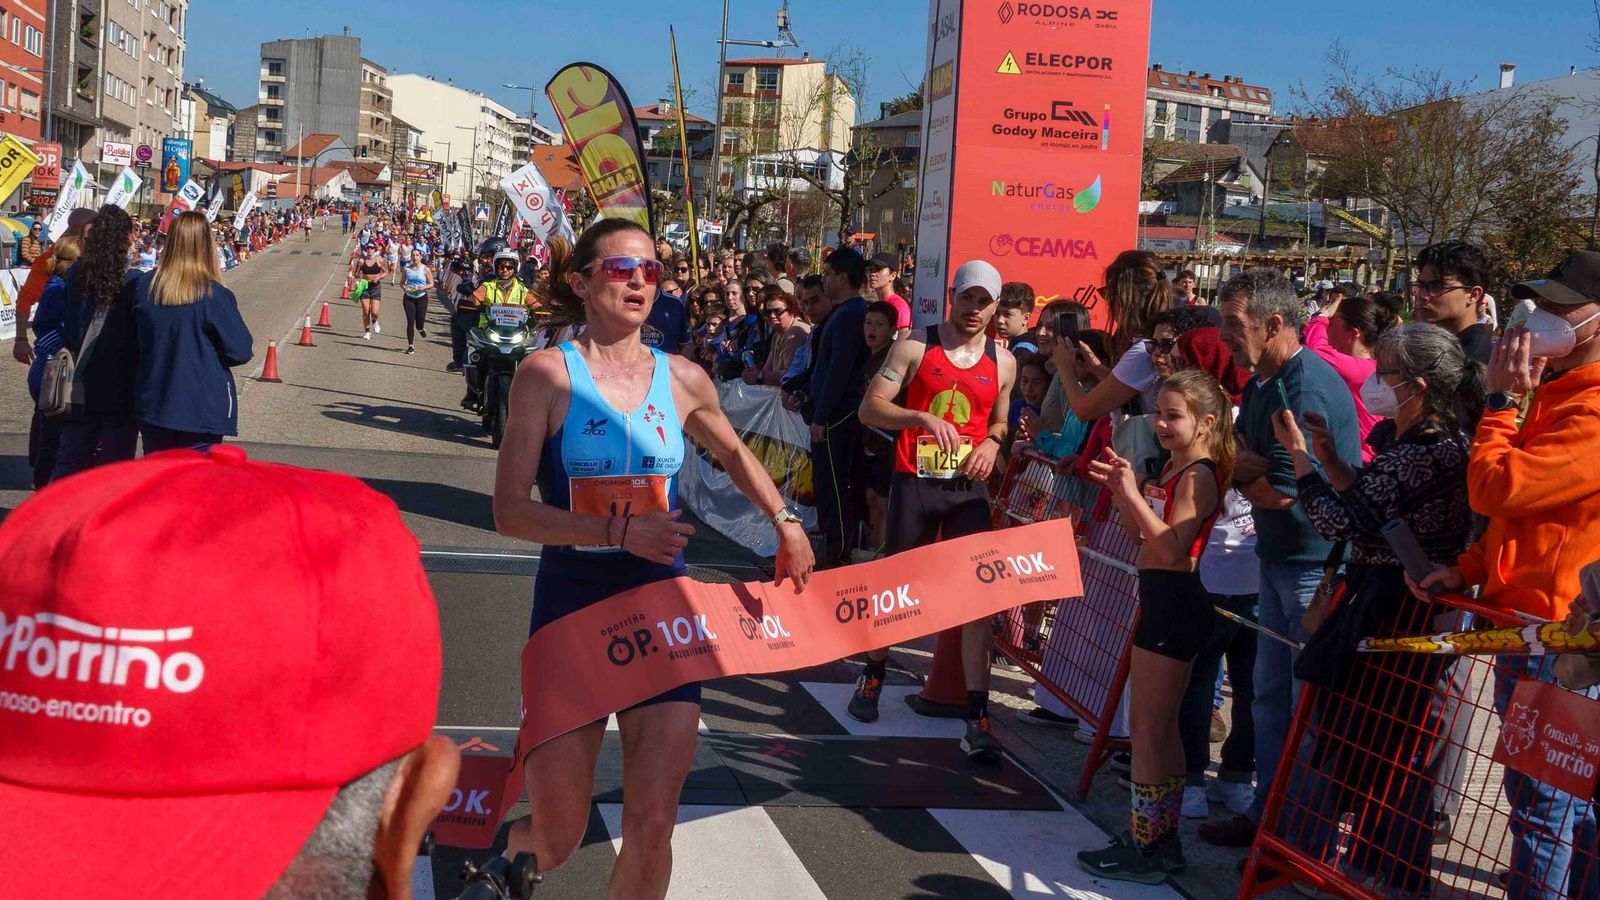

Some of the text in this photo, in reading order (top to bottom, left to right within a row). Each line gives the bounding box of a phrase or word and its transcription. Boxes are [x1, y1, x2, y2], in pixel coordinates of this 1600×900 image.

[1017, 3, 1091, 20] RODOSA
[1025, 52, 1113, 71] ELECPOR
[1004, 108, 1047, 122] Grupo
[992, 124, 1099, 141] Godoy Maceira
[991, 180, 1074, 200] NaturGas
[33, 196, 56, 205] 2026
[1030, 203, 1070, 213] energy
[1014, 237, 1098, 260] CEAMSA
[582, 427, 606, 436] ZICO
[934, 451, 959, 470] 126
[835, 584, 868, 597] oporriño
[601, 614, 645, 636] oporriño
[443, 788, 491, 815] 0K.
